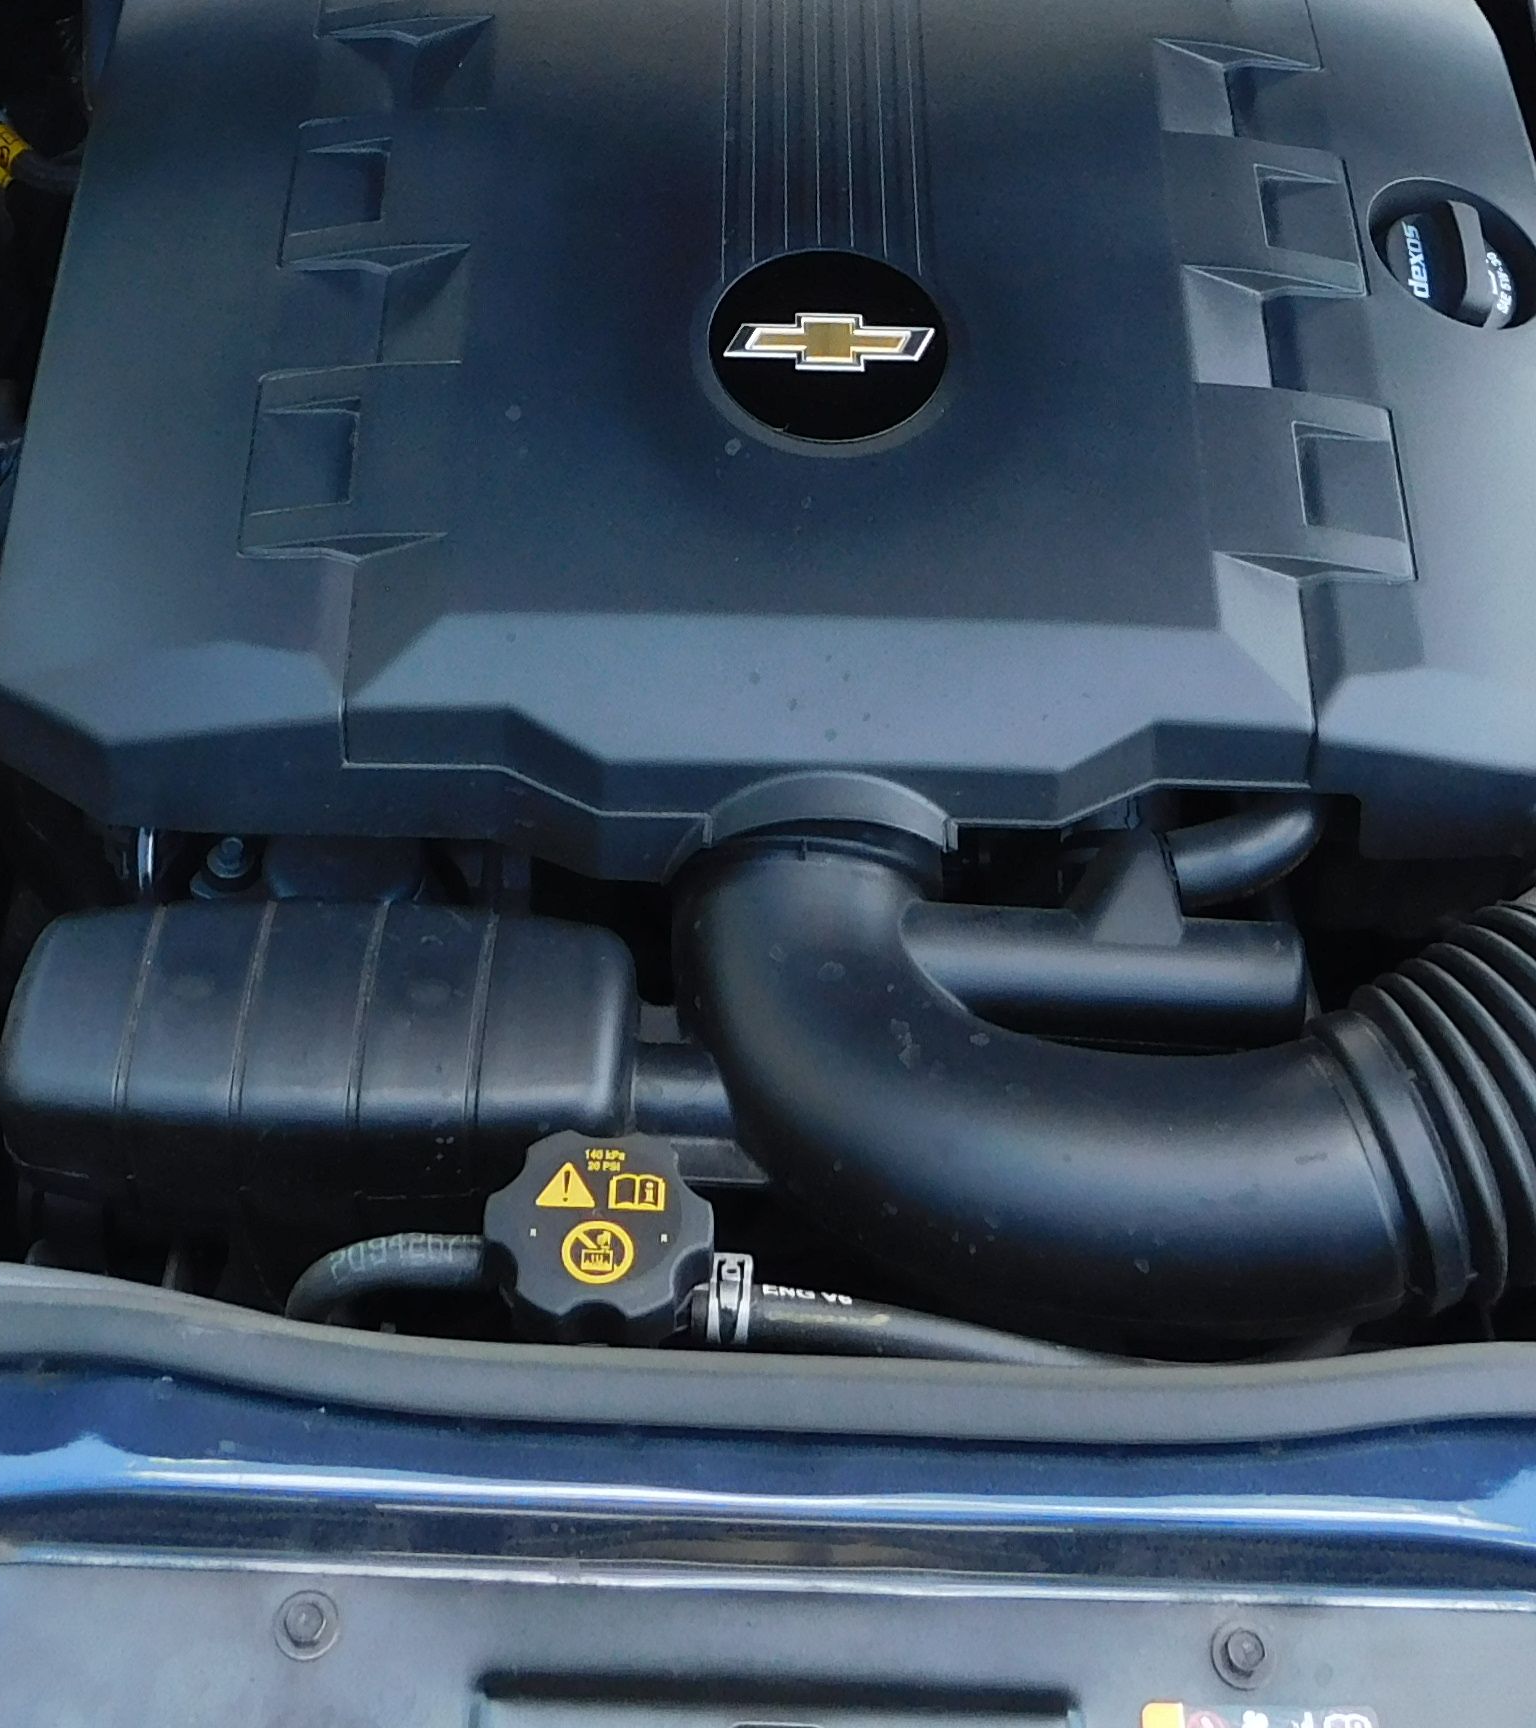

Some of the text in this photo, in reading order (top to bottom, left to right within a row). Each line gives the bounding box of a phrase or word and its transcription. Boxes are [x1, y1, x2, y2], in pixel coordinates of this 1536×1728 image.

[1402, 221, 1431, 299] dexos
[585, 1148, 604, 1160] 140
[602, 1161, 621, 1171] PSI
[762, 1284, 815, 1300] ENG
